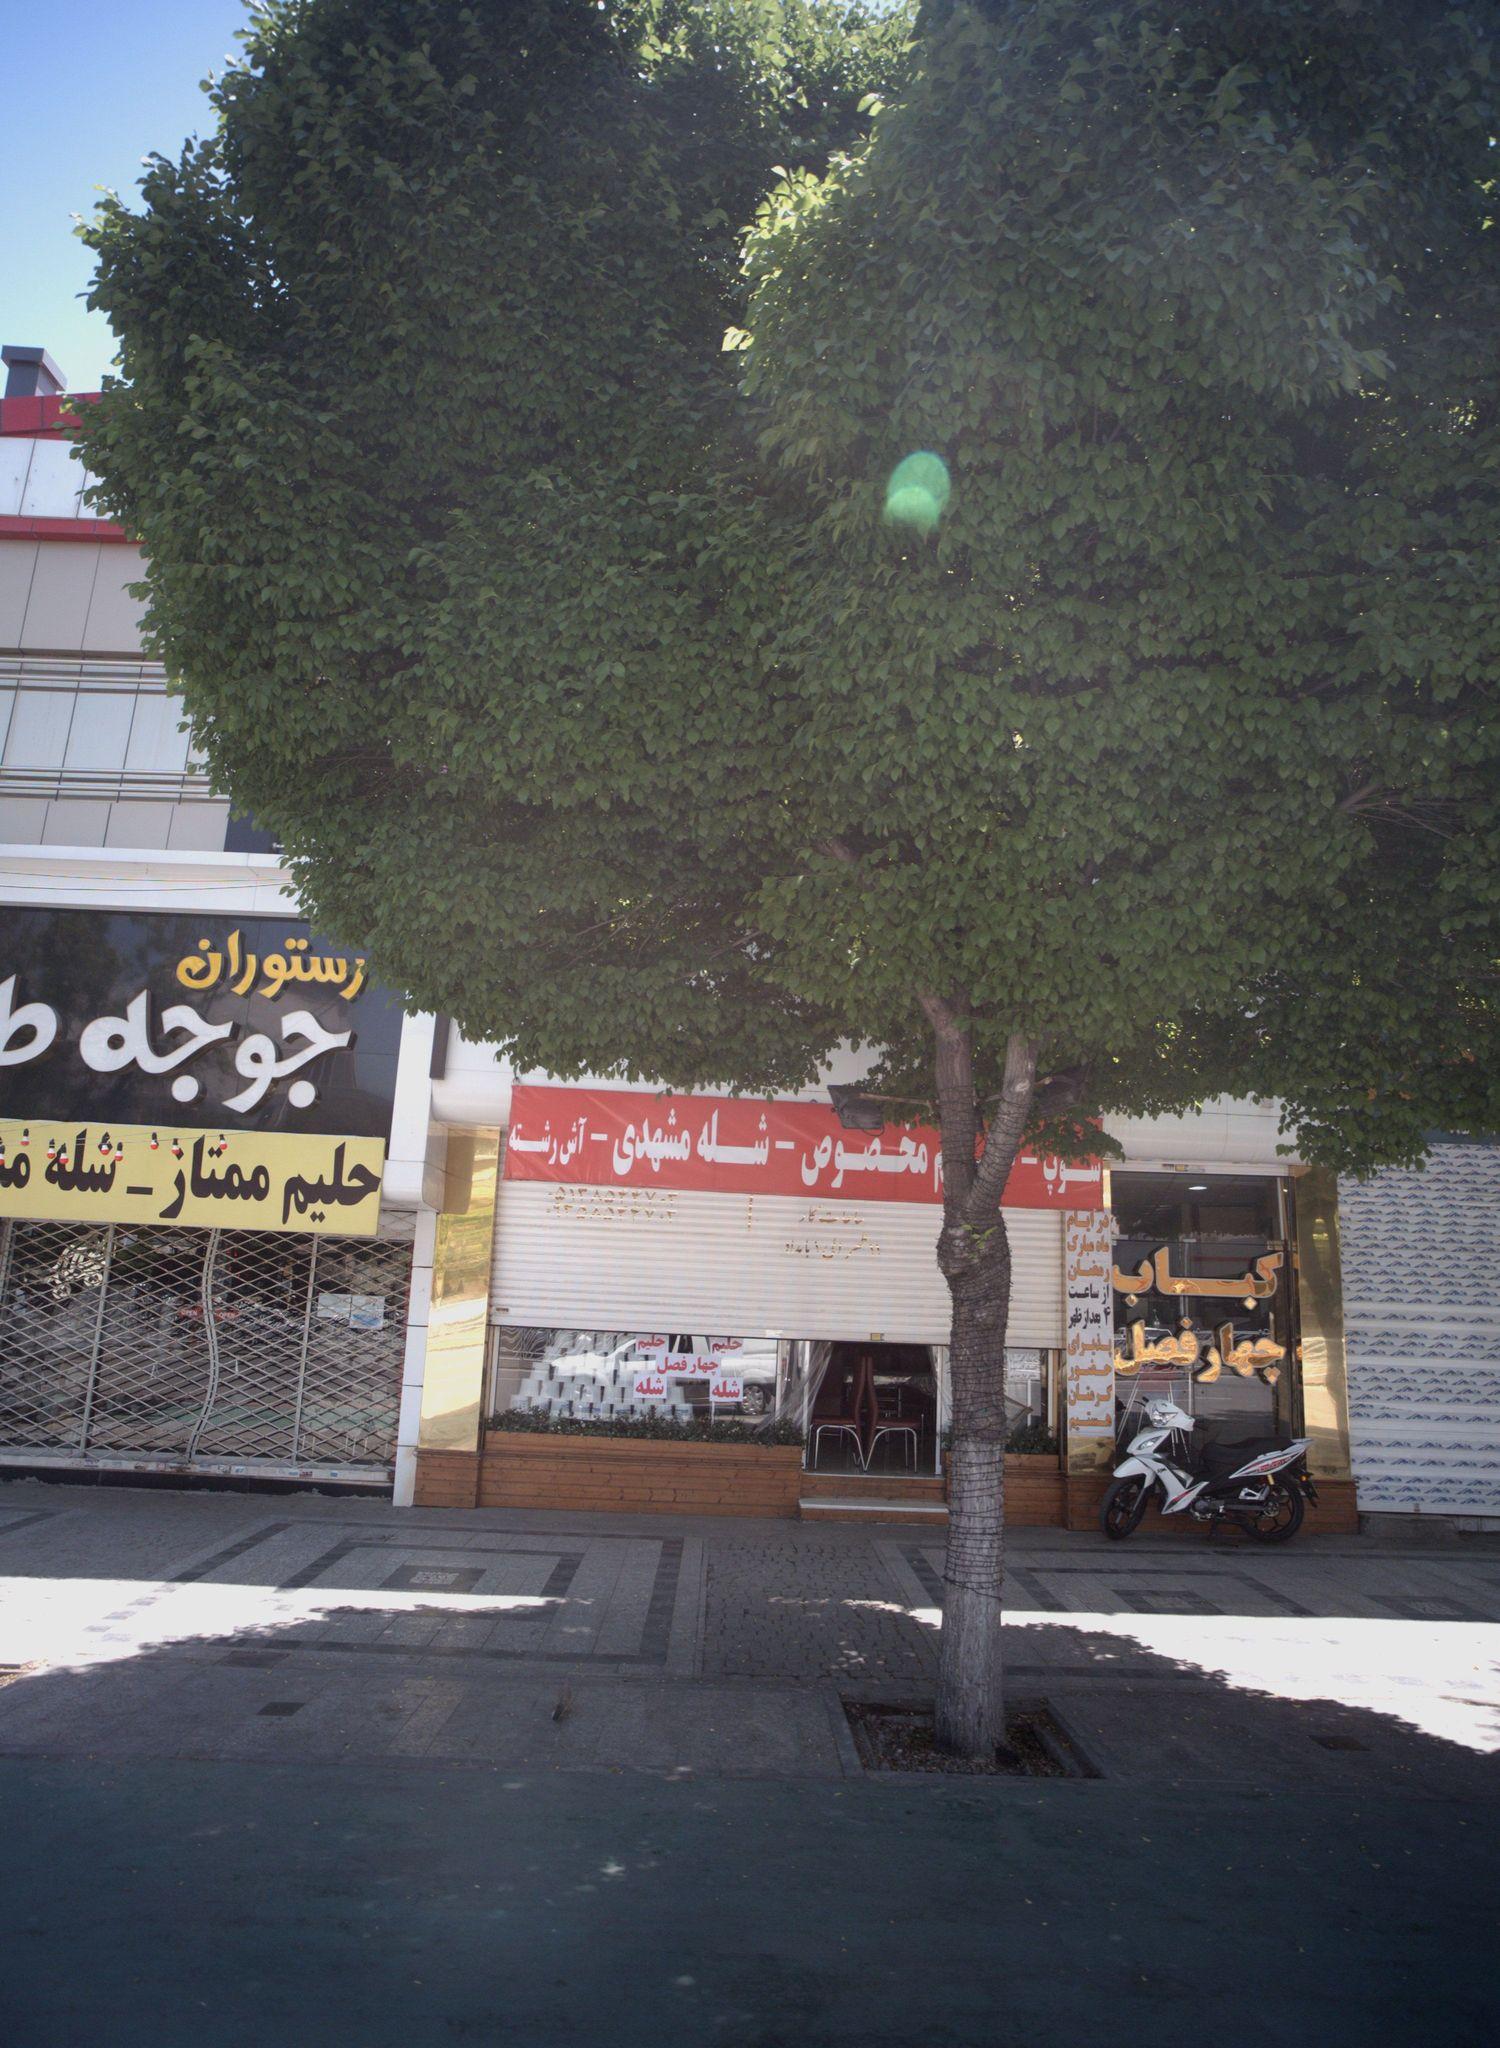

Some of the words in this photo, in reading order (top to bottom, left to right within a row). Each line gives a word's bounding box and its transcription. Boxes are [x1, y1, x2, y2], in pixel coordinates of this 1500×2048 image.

[176, 929, 366, 1001] رستوران
[80, 989, 353, 1113] جوجه
[508, 1120, 559, 1165] رشته
[559, 1116, 588, 1166] آش
[612, 1108, 691, 1176] مشهدی
[697, 1108, 769, 1166] شله
[45, 1128, 117, 1193] شله
[800, 1121, 928, 1188] مخصوص
[159, 1133, 271, 1218] ممتاز
[282, 1141, 381, 1225] حلیم
[1043, 1155, 1101, 1197] سوپ
[1067, 1209, 1095, 1233] ایام
[1096, 1214, 1110, 1234] در
[1095, 1235, 1110, 1253] ماه
[1067, 1258, 1110, 1283] رمضان
[1112, 1246, 1285, 1311] کباب
[1068, 1282, 1099, 1299] ساعت
[1101, 1283, 1110, 1304] از
[1103, 1306, 1111, 1326] ۴
[637, 1333, 666, 1351] حلیم
[711, 1336, 743, 1354] حلیم
[1068, 1333, 1112, 1358] پذیرای
[1113, 1315, 1199, 1376] فصل
[1196, 1321, 1287, 1385] چهار
[656, 1356, 688, 1375] فصل
[688, 1356, 719, 1377] چهار
[1068, 1359, 1112, 1382] حضور
[635, 1377, 665, 1396] شله
[711, 1380, 741, 1399] شله
[1069, 1411, 1112, 1432] هستیم
